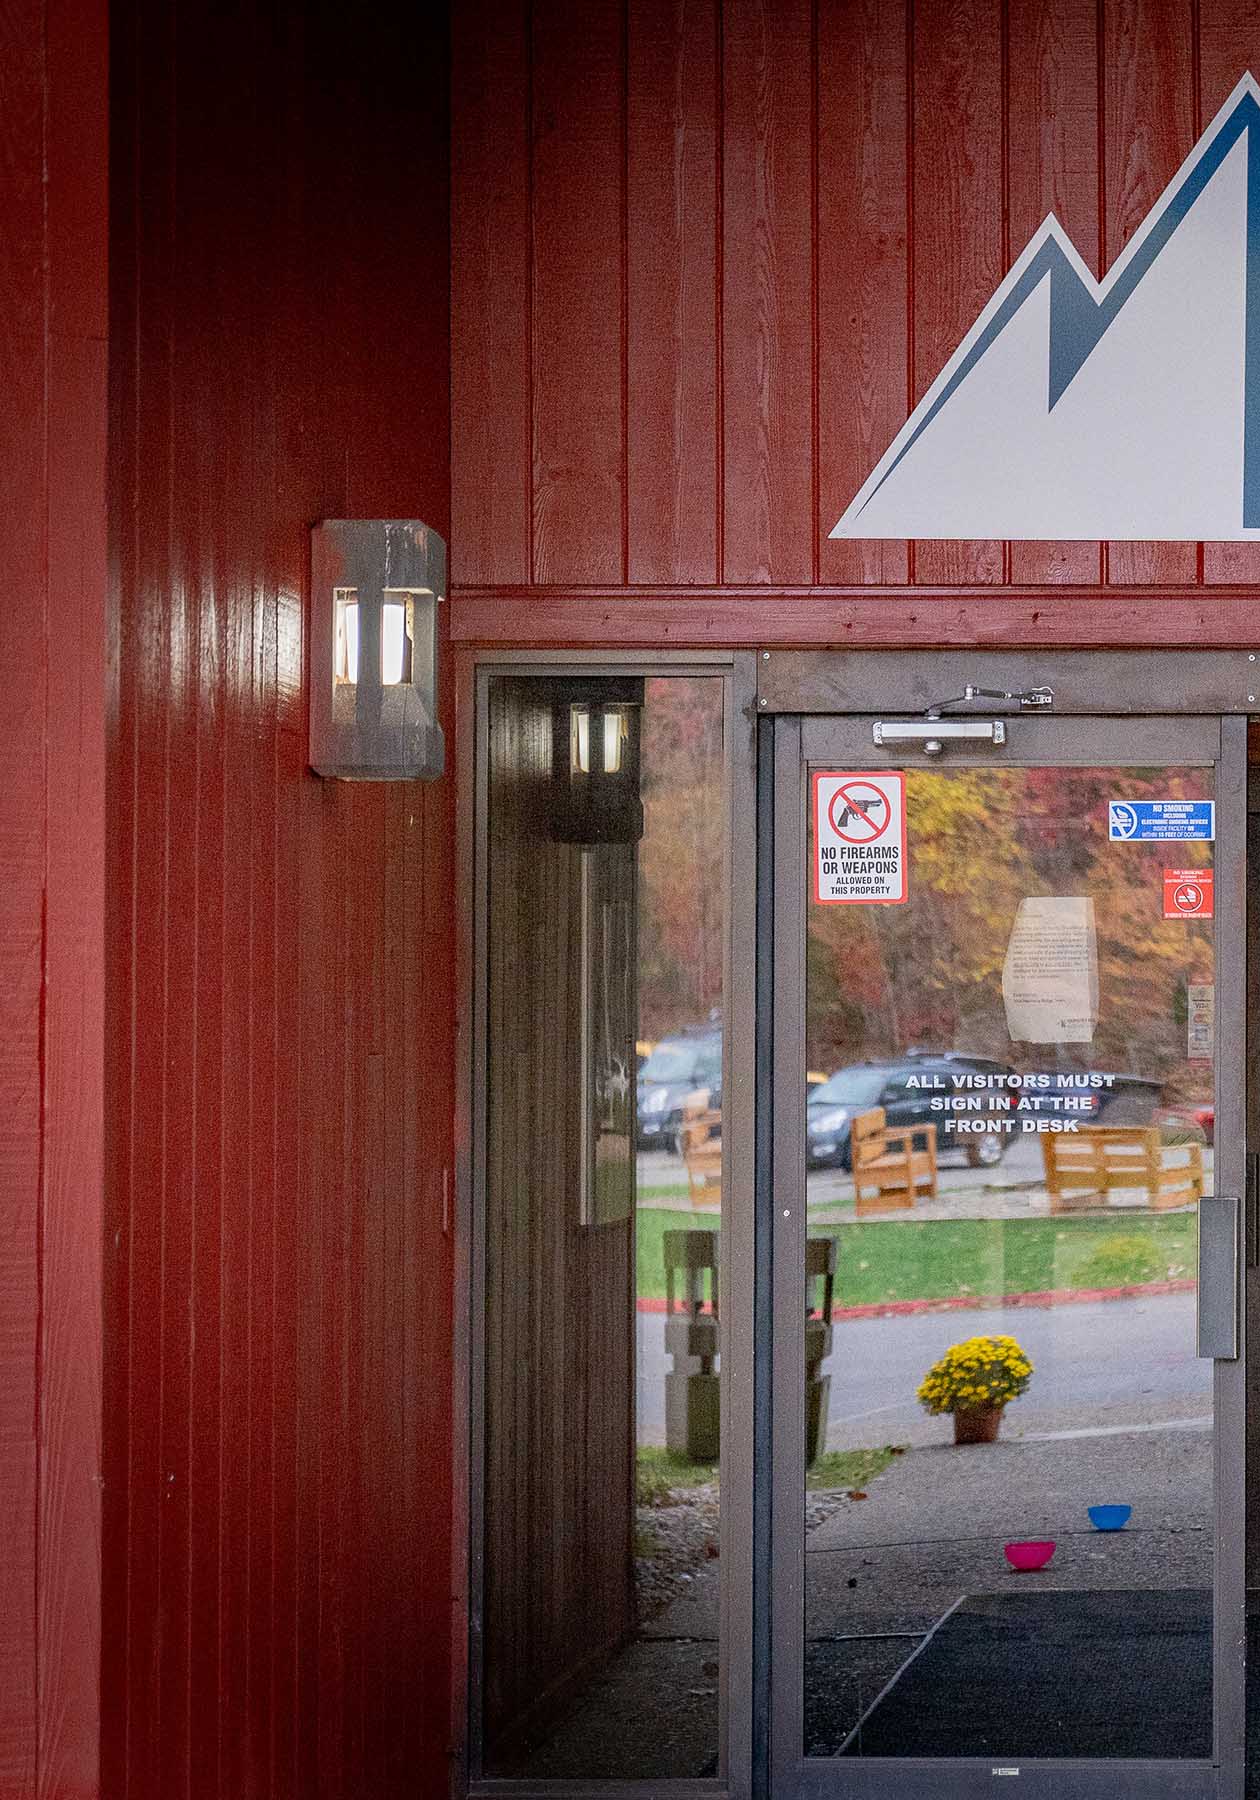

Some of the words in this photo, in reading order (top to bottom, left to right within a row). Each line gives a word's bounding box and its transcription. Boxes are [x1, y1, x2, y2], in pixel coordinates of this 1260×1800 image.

[1163, 804, 1194, 812] SMOKING
[821, 847, 836, 859] NO
[840, 846, 899, 859] FIREARMS
[823, 862, 838, 874] OR
[842, 861, 897, 874] WEAPONS
[836, 877, 872, 885] ALLOWED
[874, 876, 885, 884] ON
[831, 887, 848, 895] THIS
[850, 886, 890, 895] PROPERTY
[905, 1075, 945, 1088] ALL
[951, 1075, 1050, 1088] VISITORS
[1056, 1074, 1116, 1088] MUST
[930, 1097, 983, 1111] SIGN
[988, 1097, 1011, 1111] IN
[1017, 1097, 1045, 1111] AT
[1047, 1097, 1093, 1110] THE
[944, 1119, 1016, 1133] FRONT
[1022, 1119, 1079, 1133] DESK
